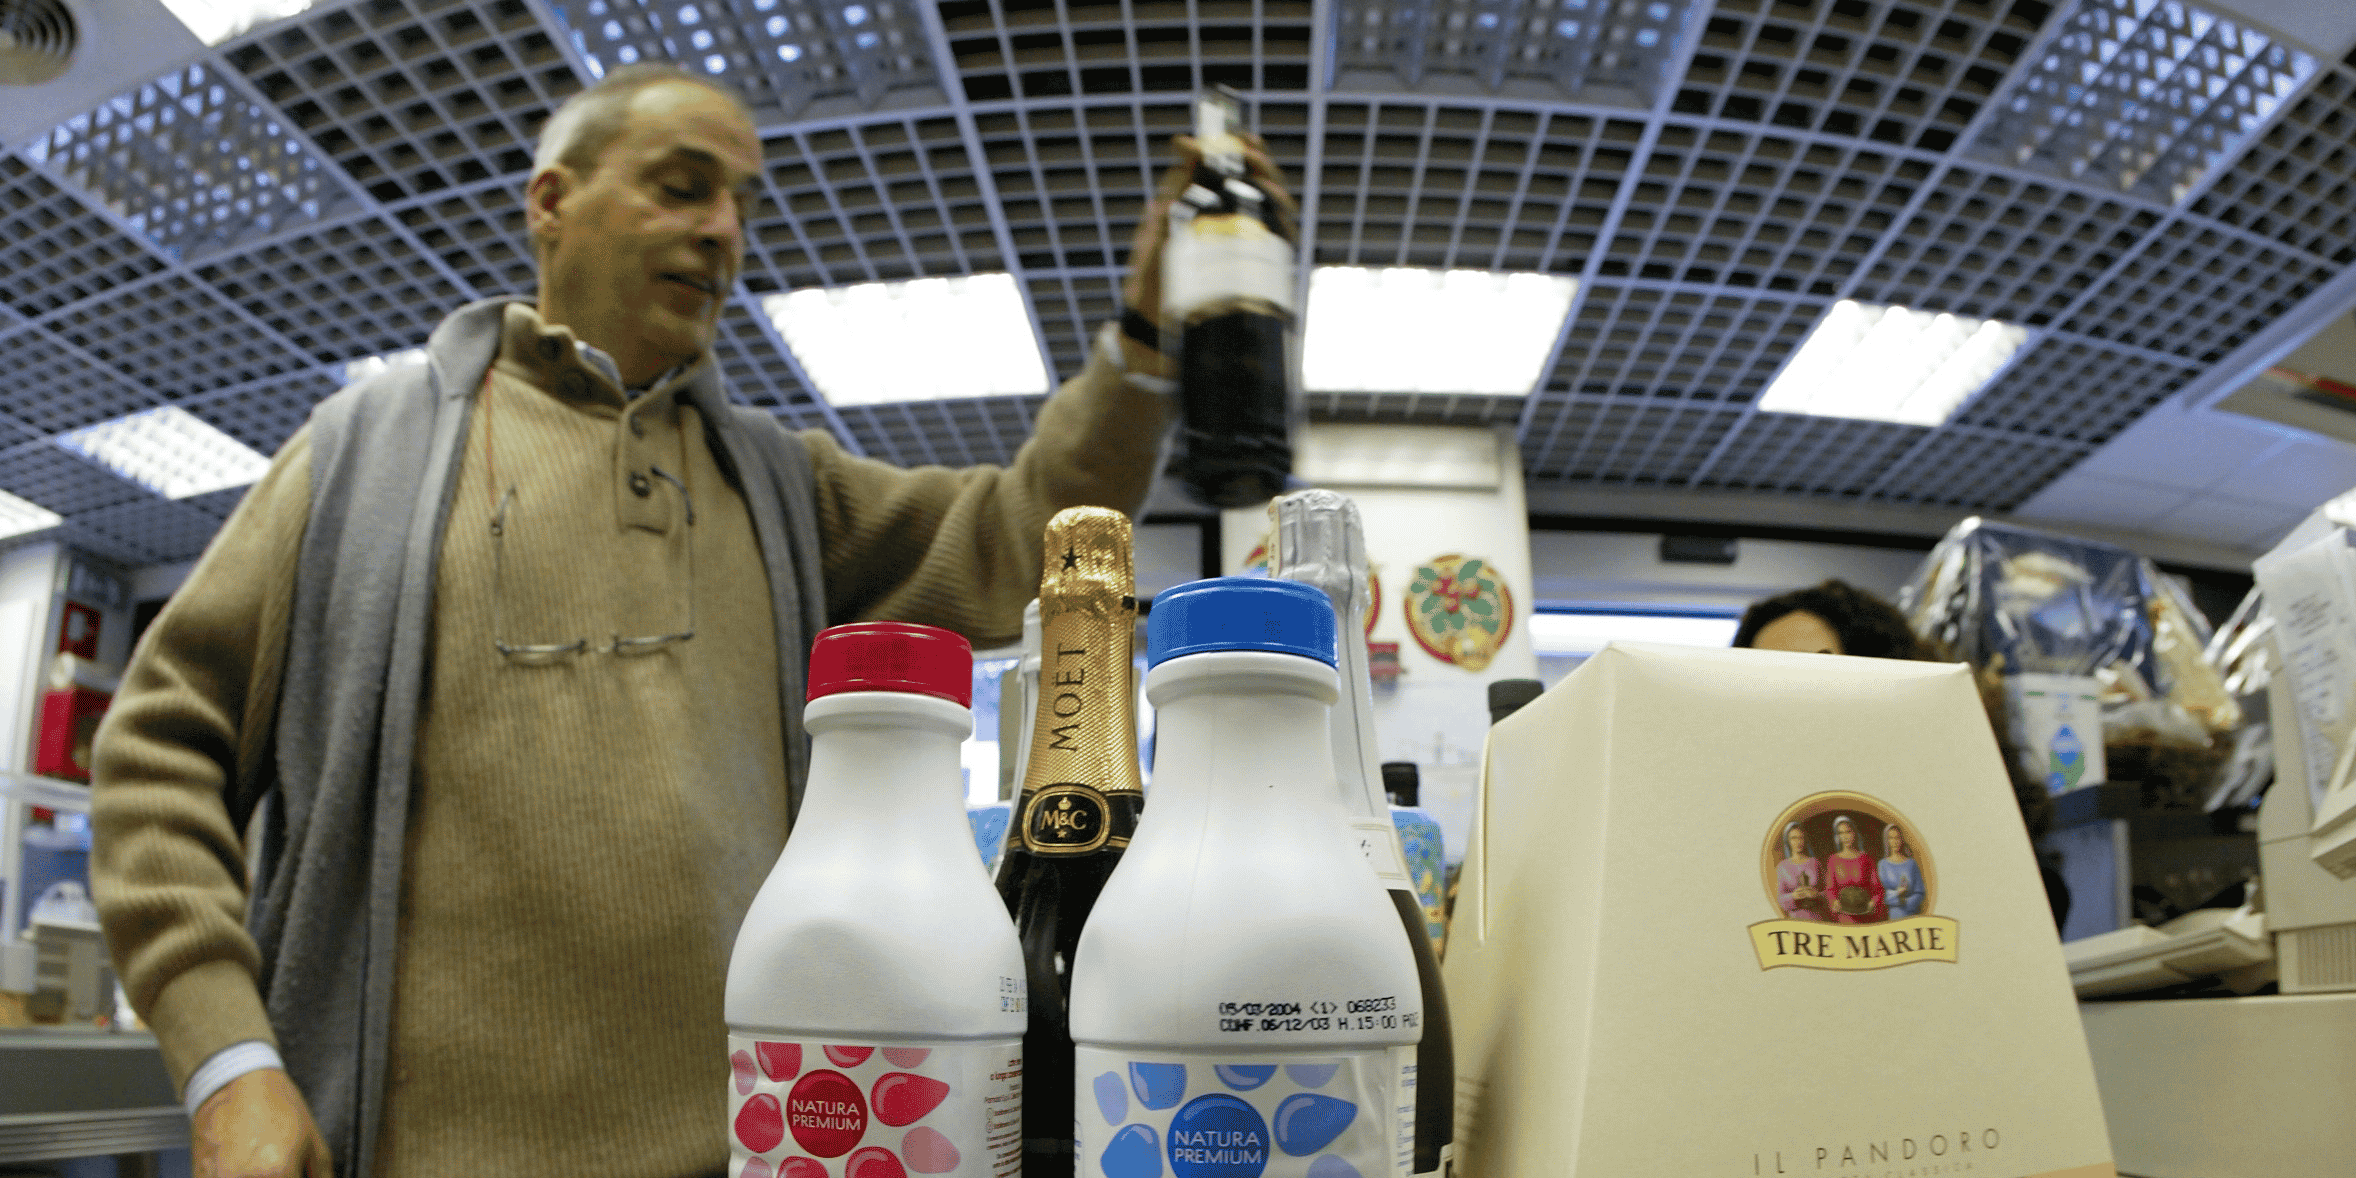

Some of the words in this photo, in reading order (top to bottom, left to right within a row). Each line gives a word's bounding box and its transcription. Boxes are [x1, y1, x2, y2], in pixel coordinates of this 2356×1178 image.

[1040, 809, 1087, 831] M&C
[1767, 930, 1834, 958] TRE
[1844, 927, 1945, 959] MARIE
[792, 1099, 860, 1115] NATURA
[792, 1114, 861, 1130] PREMIUM
[1174, 1130, 1260, 1147] NATURA
[1174, 1148, 1261, 1164] PREMIUM
[1754, 1151, 1786, 1175] IL
[1816, 1128, 2000, 1169] PANDORO
